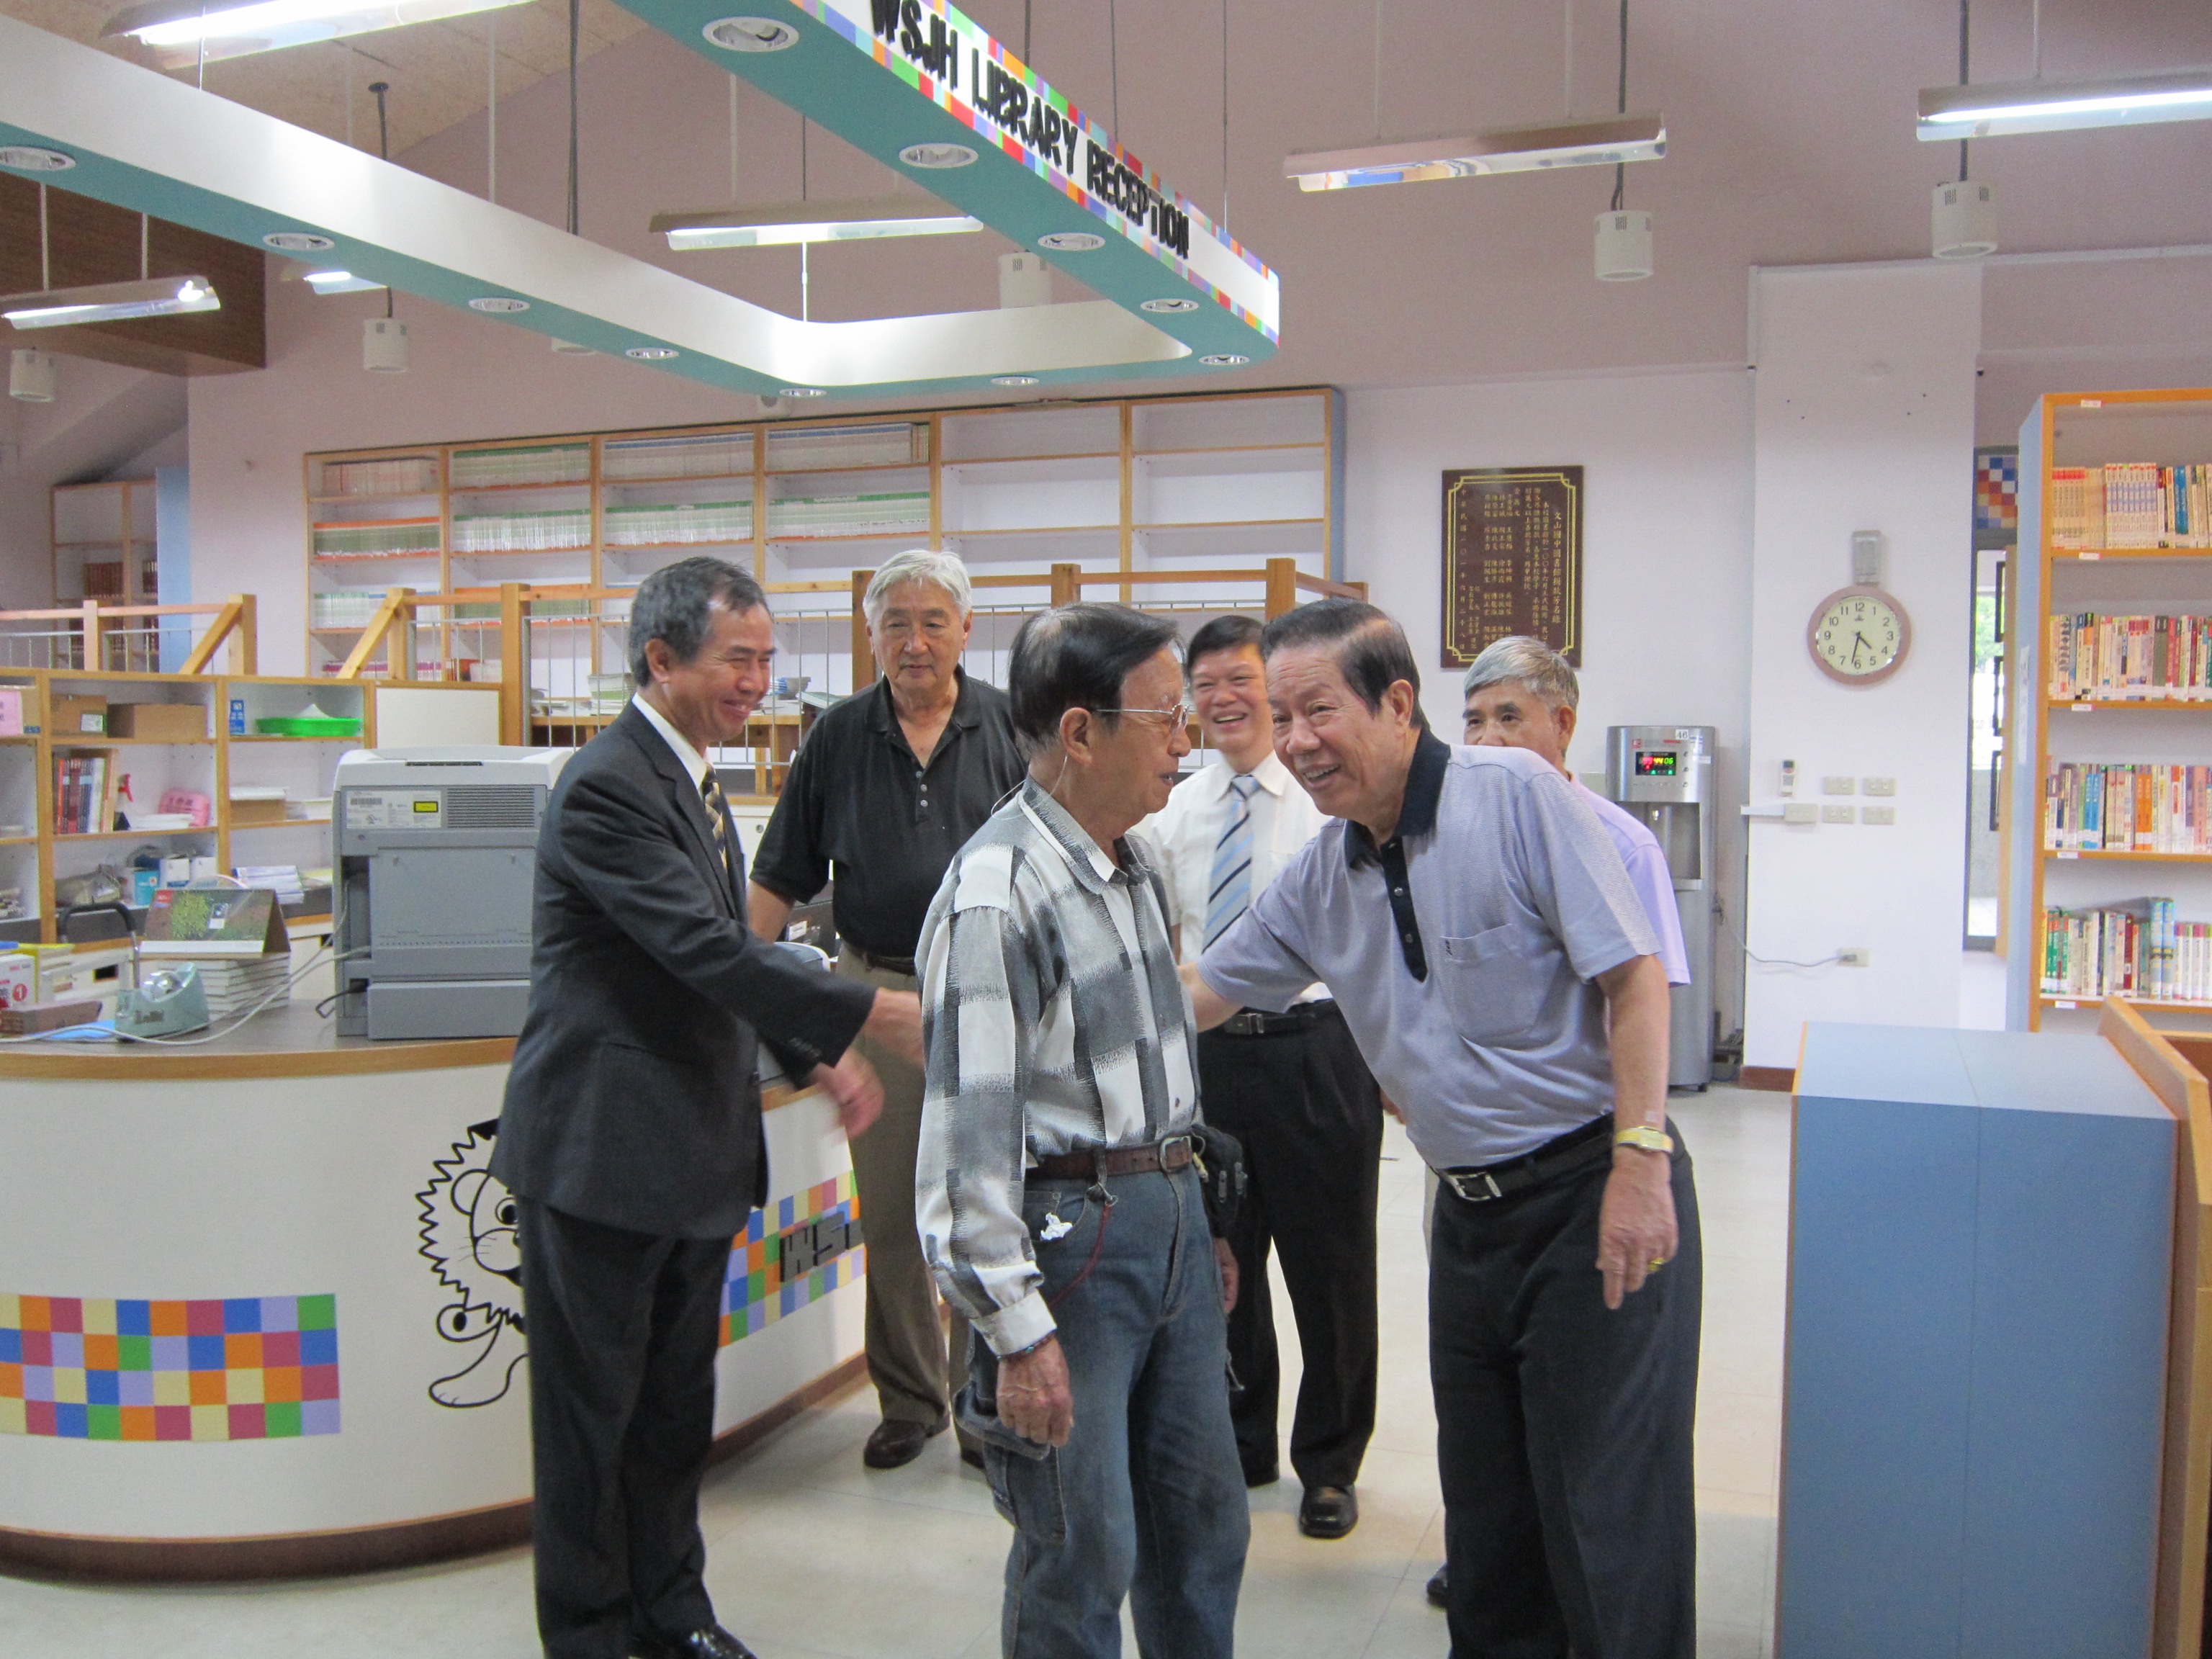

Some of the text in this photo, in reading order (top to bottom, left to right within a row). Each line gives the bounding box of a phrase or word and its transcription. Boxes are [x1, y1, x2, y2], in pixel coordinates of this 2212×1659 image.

[871, 0, 1190, 260] WSJH LIBRARY RECEPTION
[1840, 606, 1849, 616] 11
[1855, 602, 1865, 612] 12
[1829, 616, 1839, 626] 10
[1883, 617, 1890, 626] 2
[1824, 631, 1831, 640] 9
[1887, 631, 1894, 641] 3
[1828, 645, 1835, 655] 8
[1881, 646, 1888, 655] 4
[1839, 656, 1846, 665] 7
[1854, 660, 1861, 669] 6
[1869, 657, 1876, 665] 5
